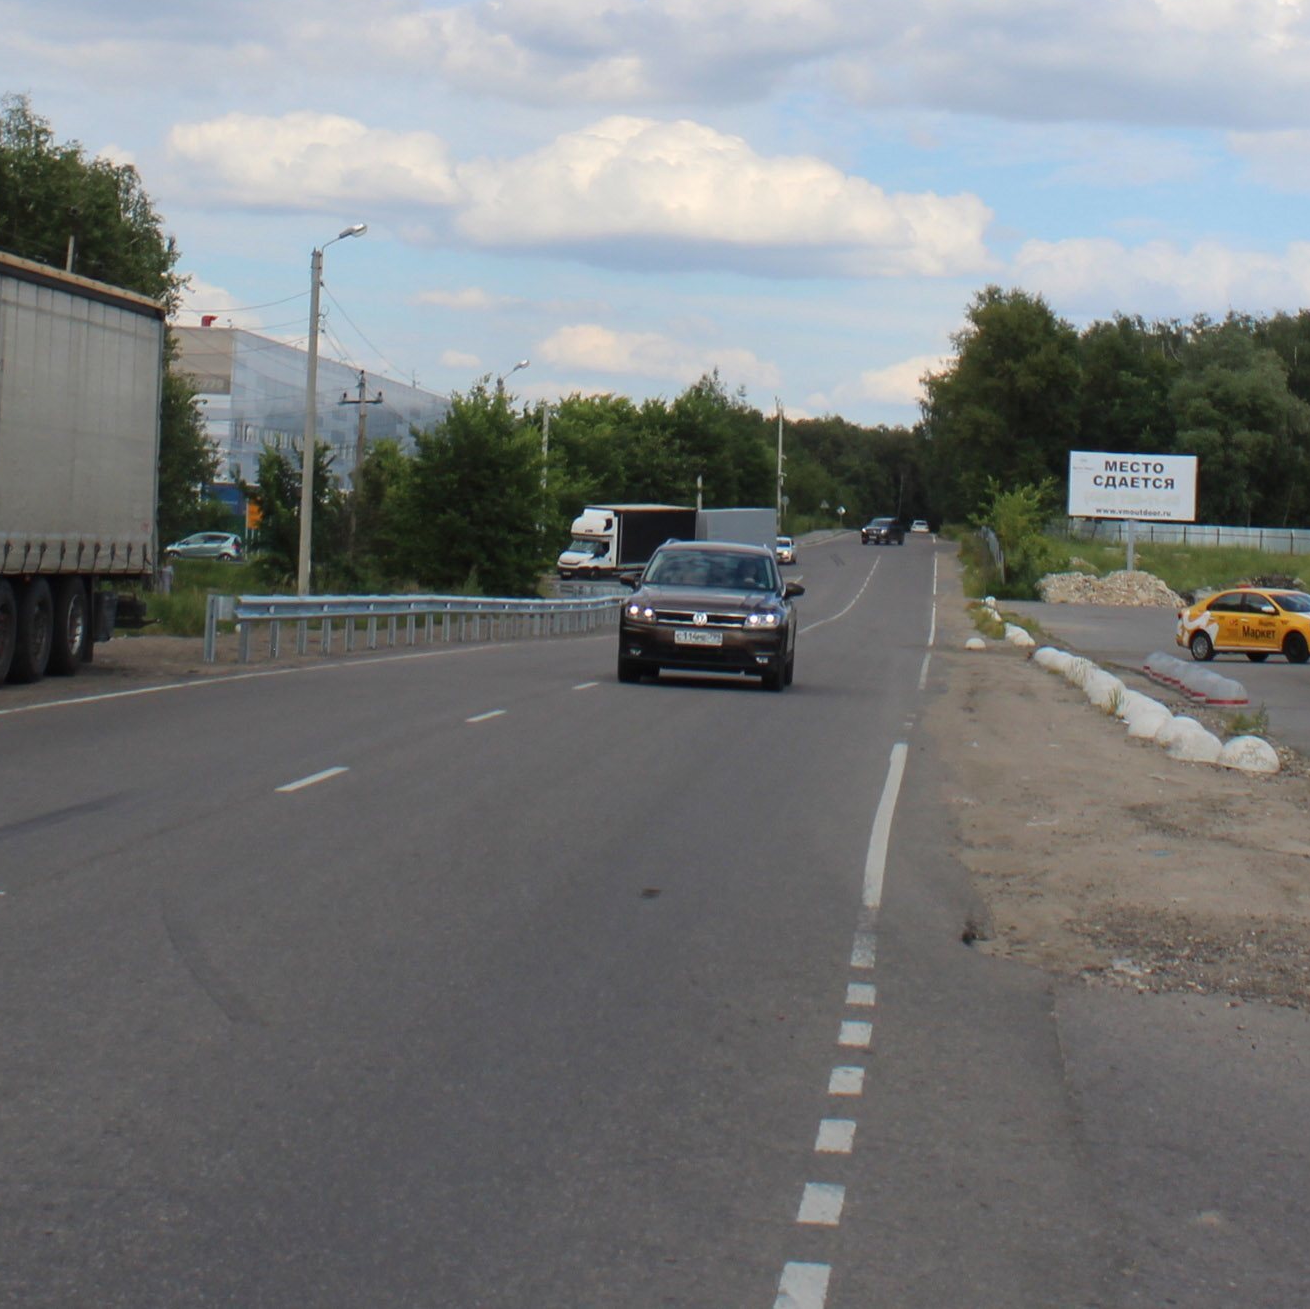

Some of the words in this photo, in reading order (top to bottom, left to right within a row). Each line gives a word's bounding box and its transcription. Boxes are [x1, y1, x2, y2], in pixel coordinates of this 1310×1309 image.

[1104, 460, 1165, 474] МЕСТО
[1093, 475, 1175, 489] СДАЕТСЯ
[1095, 508, 1172, 517] www.vmoutdoor.ru
[1242, 625, 1276, 641] Маркет
